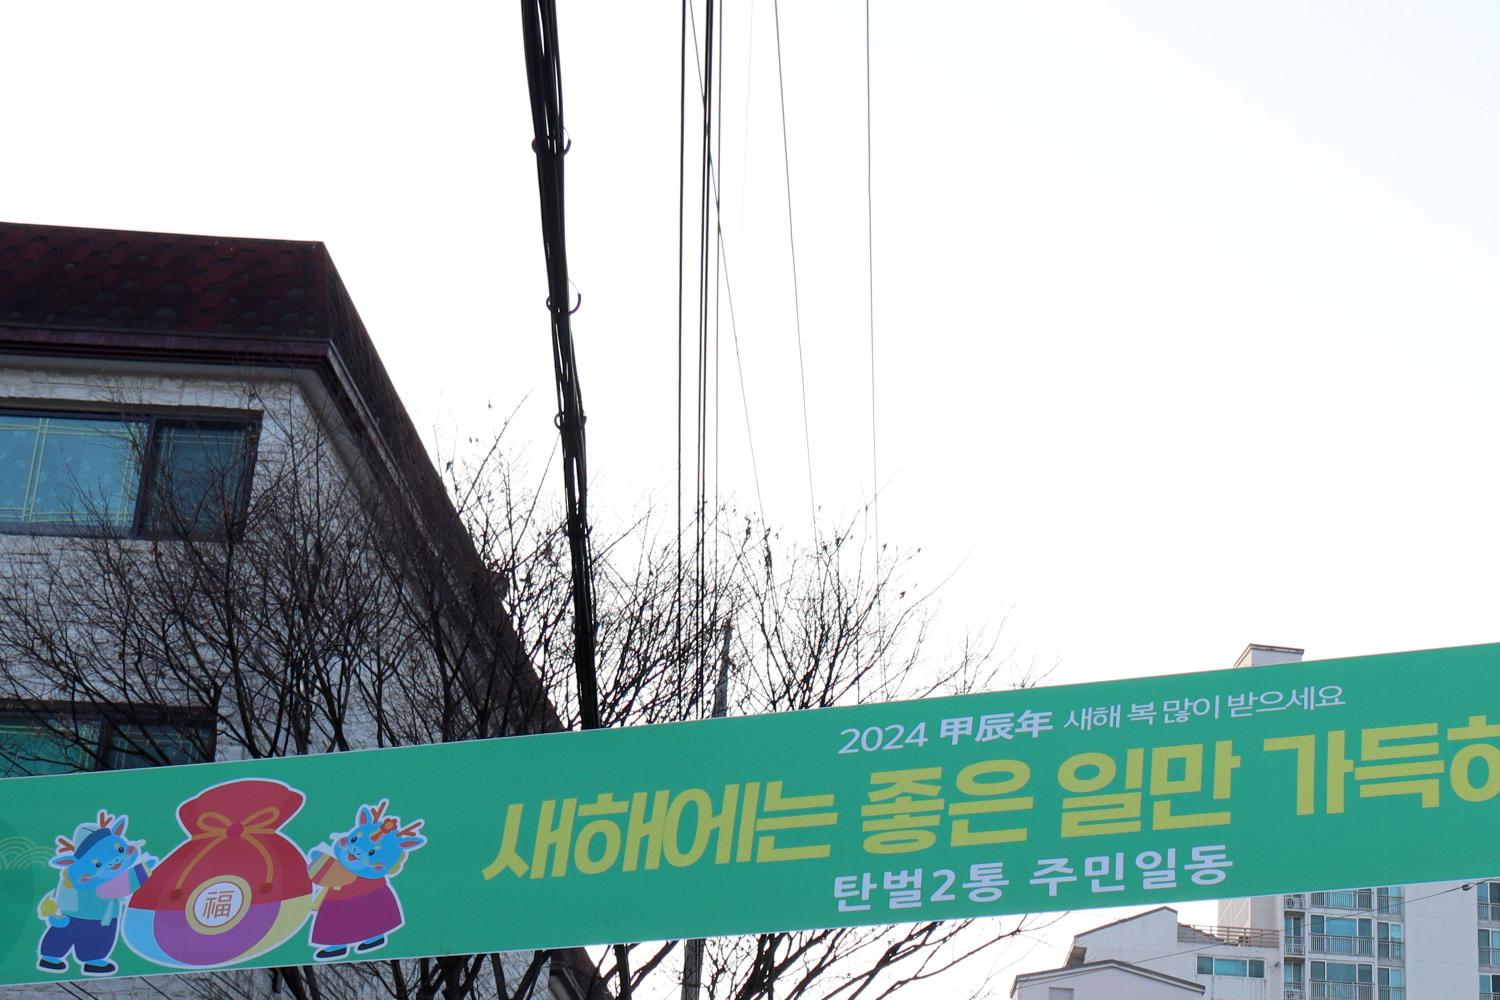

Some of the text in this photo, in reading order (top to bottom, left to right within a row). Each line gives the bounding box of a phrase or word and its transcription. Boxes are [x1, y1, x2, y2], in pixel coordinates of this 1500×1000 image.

[837, 684, 1347, 754] 2024 甲辰年 새해 복 많이 받으세요
[481, 780, 838, 880] 새해에는
[861, 758, 1034, 855] 좋은
[1057, 739, 1241, 839] 일만
[202, 889, 235, 920] 福
[833, 844, 1234, 913] 탄벌2통 주민일동
